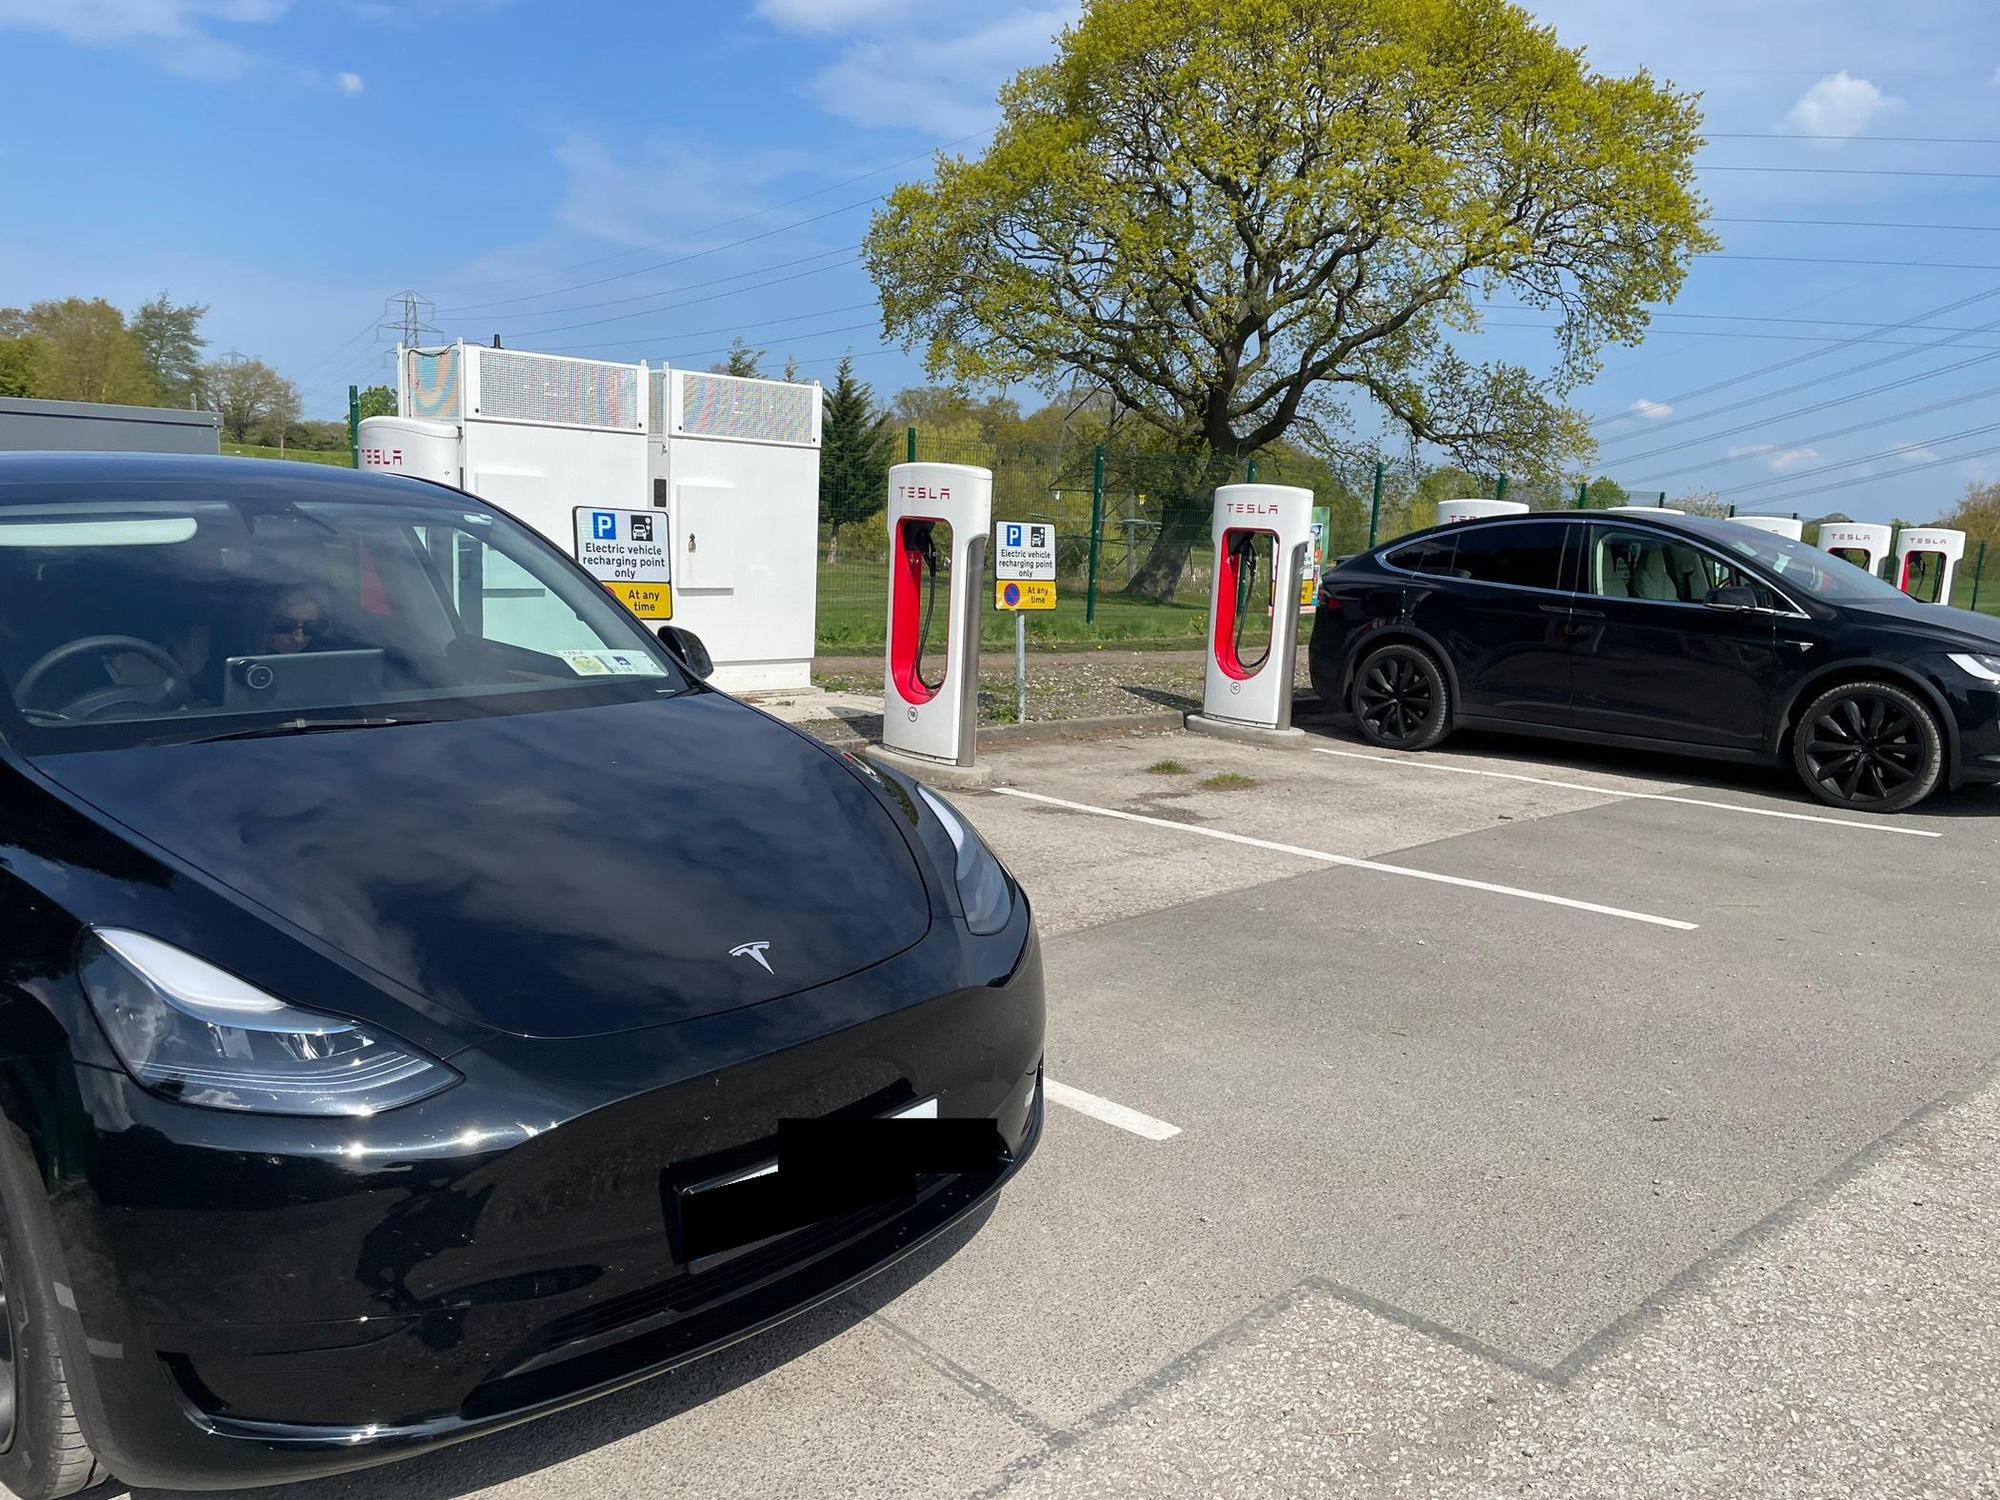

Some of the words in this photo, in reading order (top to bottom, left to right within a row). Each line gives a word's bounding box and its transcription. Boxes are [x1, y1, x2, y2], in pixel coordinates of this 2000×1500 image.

[361, 448, 403, 466] TESLA
[898, 486, 950, 500] TESLA
[1226, 503, 1278, 515] TESLA
[597, 515, 612, 538] P
[1009, 527, 1019, 545] P
[1831, 533, 1871, 541] TESLA
[1910, 537, 1947, 545] TESLA
[585, 543, 625, 554] Electric
[627, 545, 662, 555] vehicle
[1001, 549, 1026, 558] Electric
[1028, 550, 1051, 559] vehicle
[583, 556, 637, 568] recharging
[640, 557, 665, 568] point
[999, 559, 1034, 569] recharging
[1035, 560, 1053, 569] point
[614, 568, 636, 579] only
[1018, 569, 1033, 578] only
[628, 590, 642, 600] At
[642, 592, 660, 602] any
[1027, 586, 1036, 594] At
[1037, 588, 1048, 596] any
[1031, 595, 1046, 604] time
[634, 601, 655, 612] time
